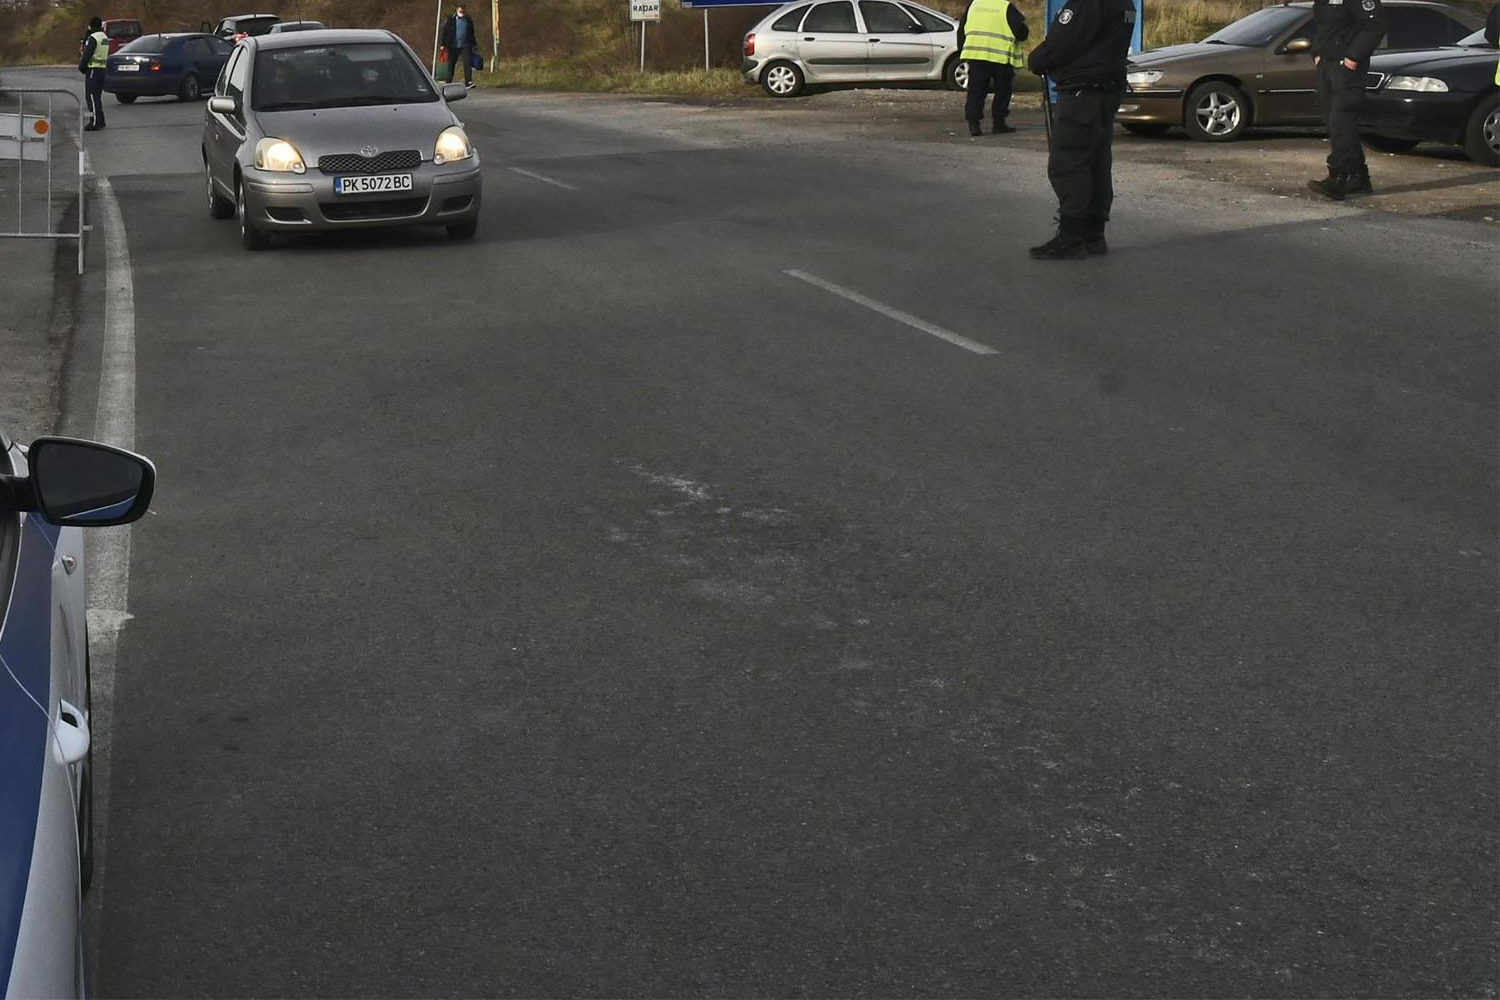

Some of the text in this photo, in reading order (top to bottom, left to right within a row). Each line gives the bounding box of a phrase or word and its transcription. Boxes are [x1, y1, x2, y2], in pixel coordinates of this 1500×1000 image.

[343, 178, 359, 191] PK
[361, 177, 391, 190] 5072
[393, 176, 410, 189] BC
